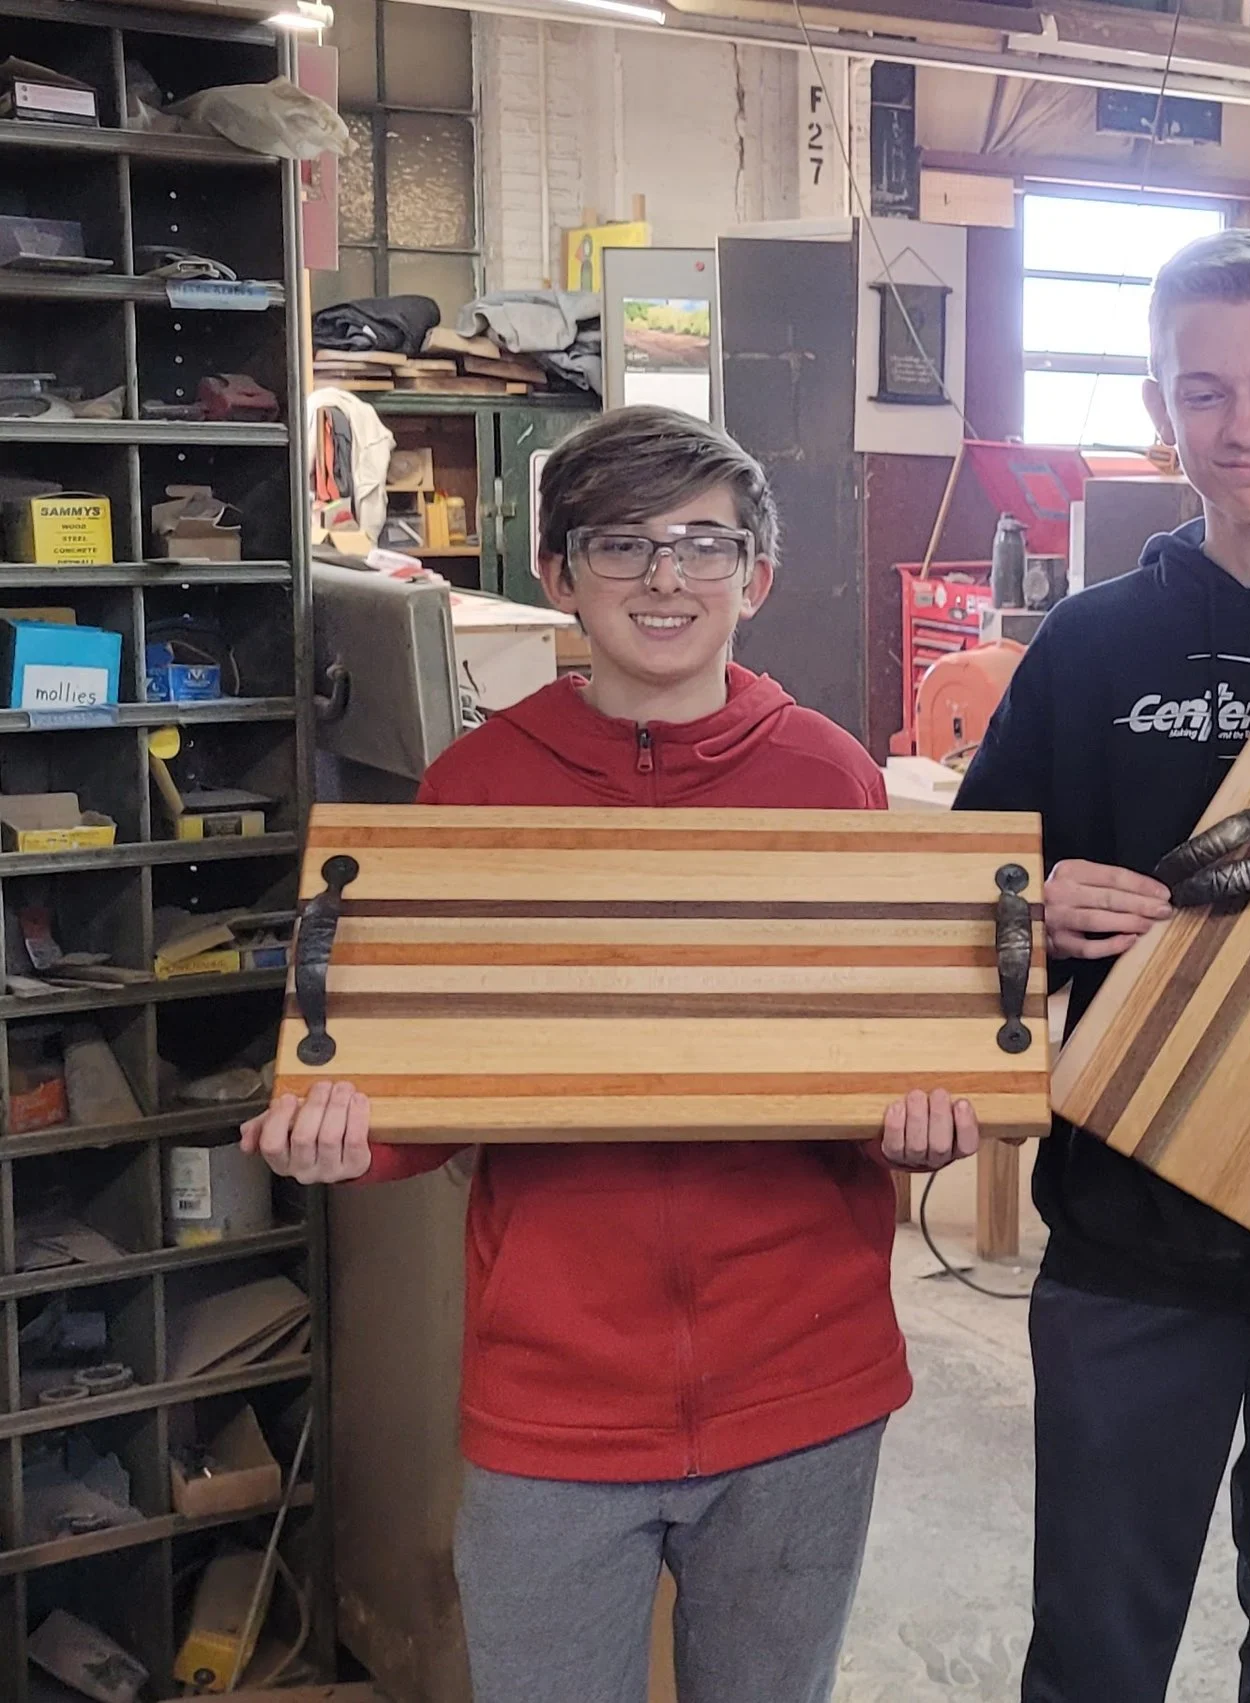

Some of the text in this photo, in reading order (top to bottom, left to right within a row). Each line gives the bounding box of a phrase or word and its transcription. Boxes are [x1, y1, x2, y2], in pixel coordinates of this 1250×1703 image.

[40, 506, 101, 517] SAMMYS
[35, 681, 97, 705] mollies
[1169, 728, 1198, 740] Making
